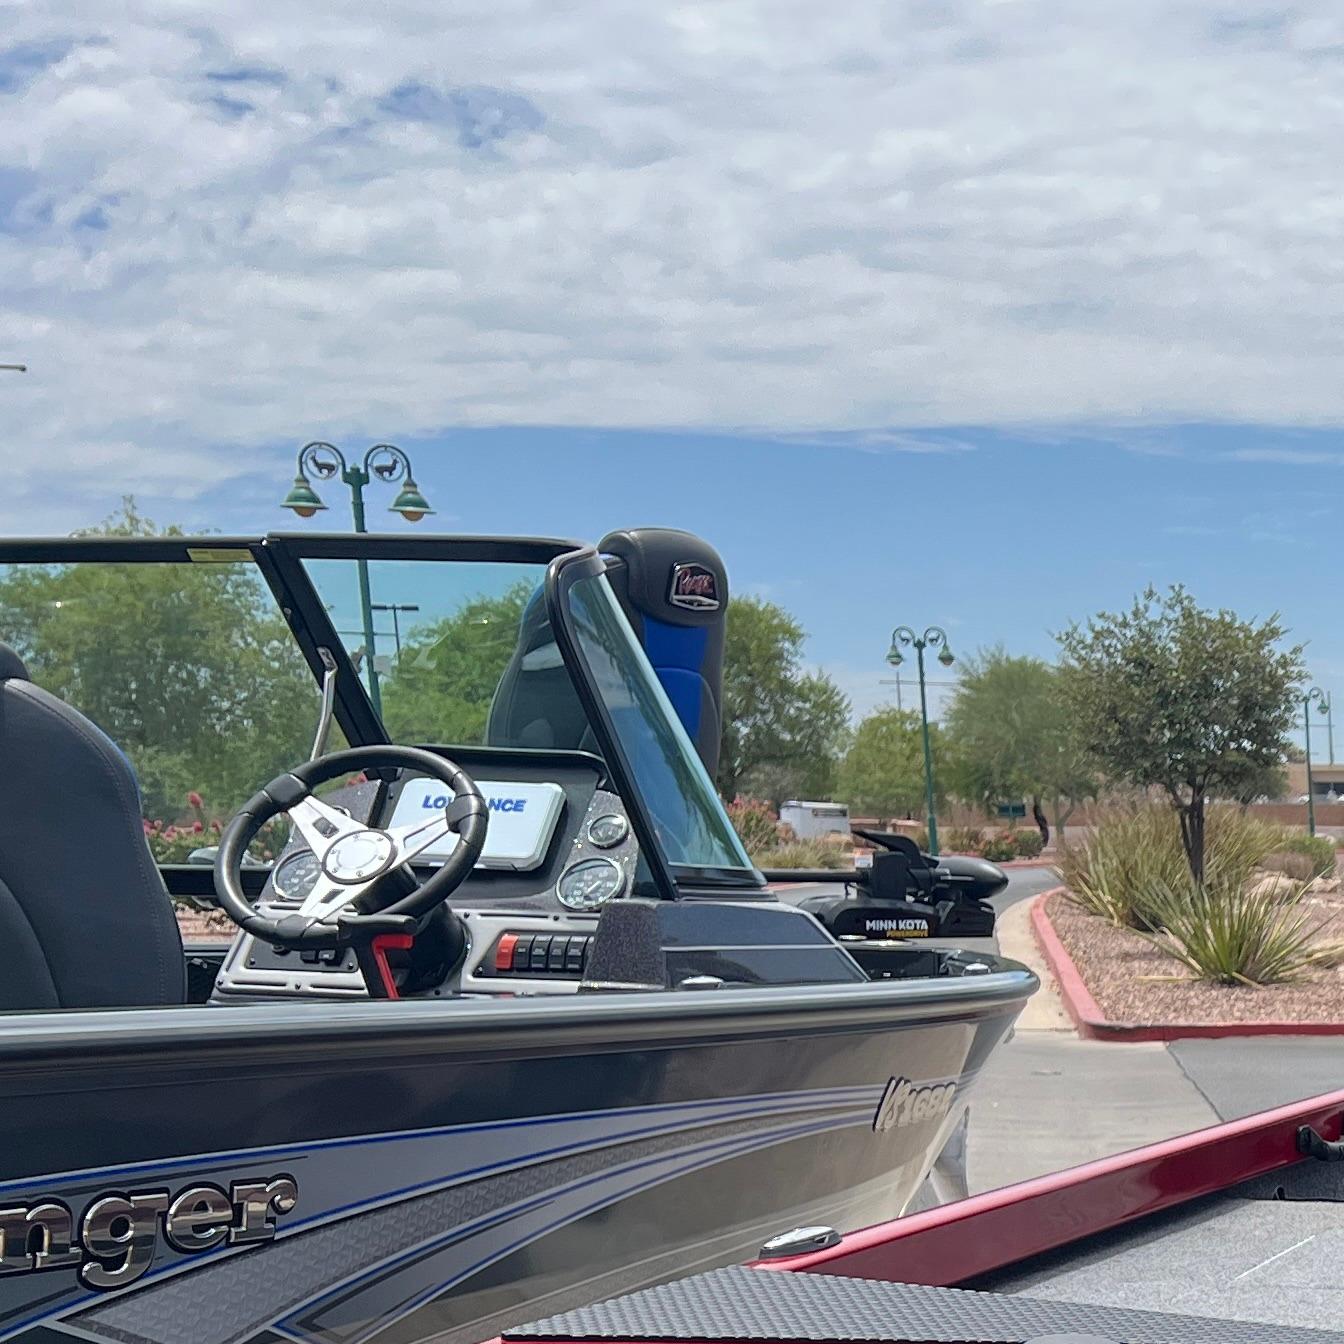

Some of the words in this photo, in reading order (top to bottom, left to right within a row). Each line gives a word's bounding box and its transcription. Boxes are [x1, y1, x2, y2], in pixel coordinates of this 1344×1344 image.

[422, 795, 527, 812] LONCE
[866, 920, 896, 931] MINN
[899, 919, 928, 930] KOTA
